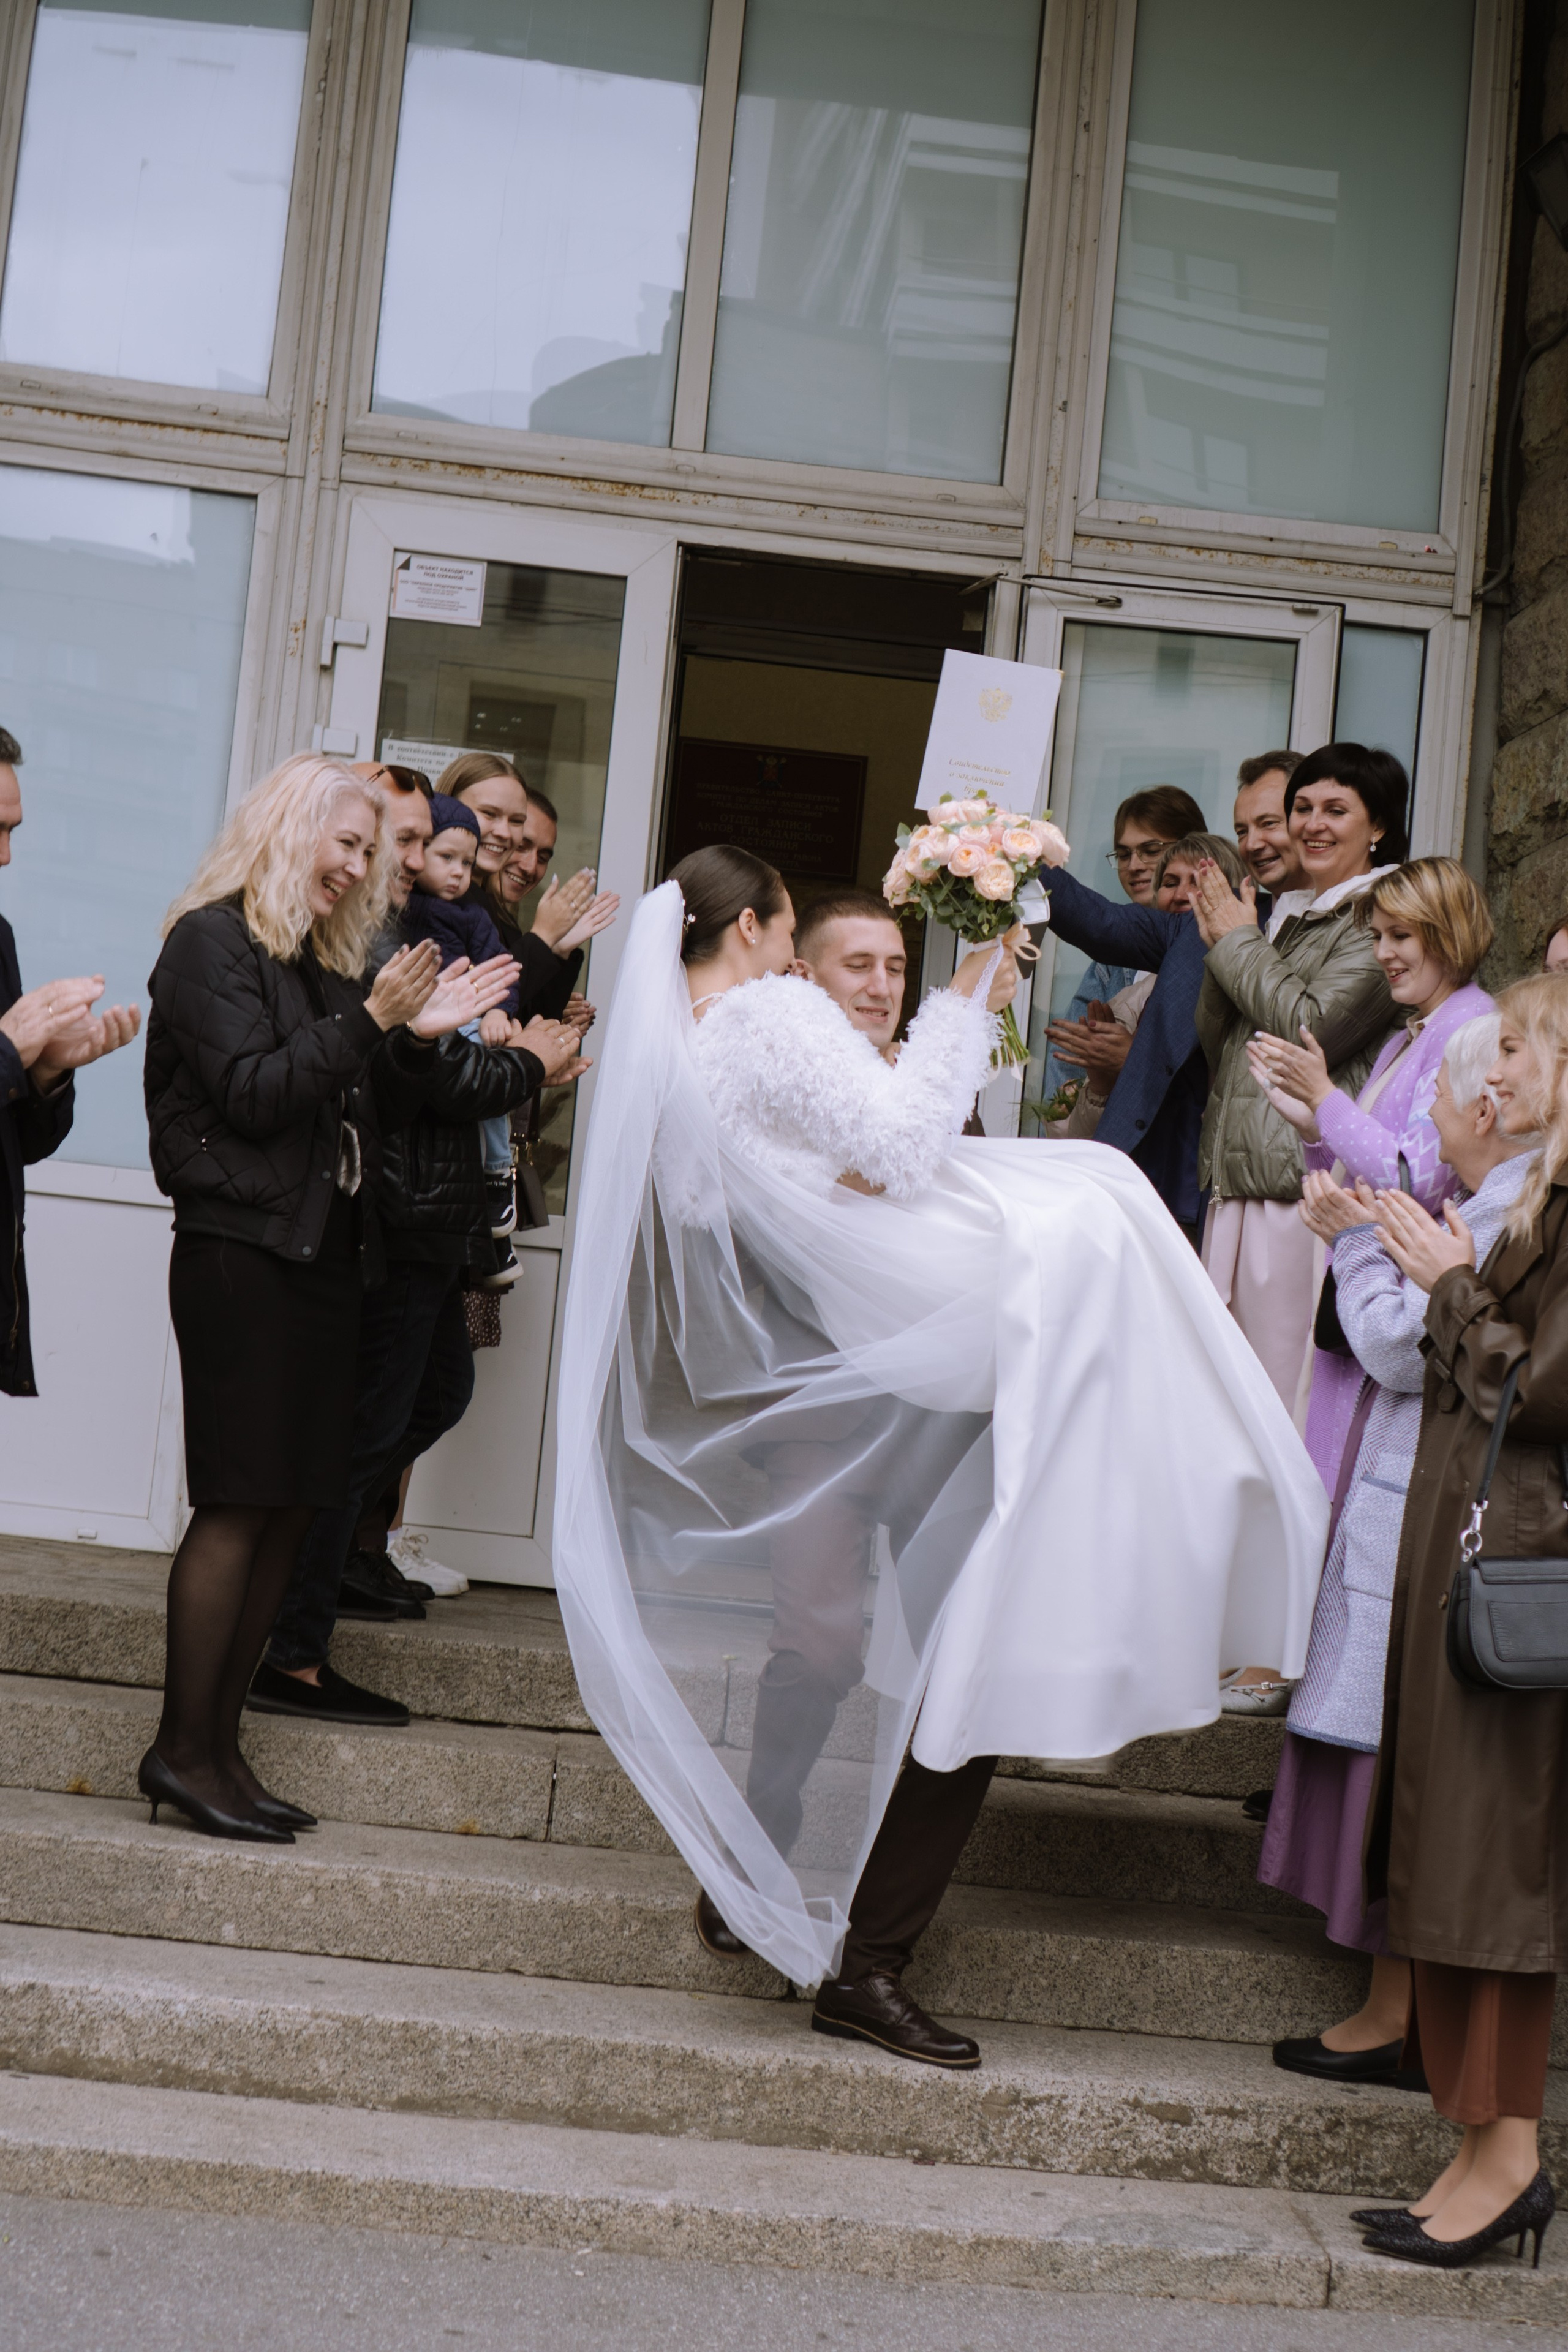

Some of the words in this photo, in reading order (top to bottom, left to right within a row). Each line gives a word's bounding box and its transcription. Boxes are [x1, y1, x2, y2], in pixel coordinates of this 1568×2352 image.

[440, 566, 473, 575] НАХОДИТСЯ
[397, 755, 432, 765] Комитета
[949, 758, 1011, 775] Свидетельство
[957, 773, 1005, 786] заключении
[720, 813, 759, 826] ОТДЕЛ
[767, 818, 812, 831] ЗАПИСИ
[697, 821, 733, 833] АКТОВ
[741, 825, 834, 843] ГРАЖДАНСКОГО
[729, 835, 798, 850] СОСТОЯНИЯ
